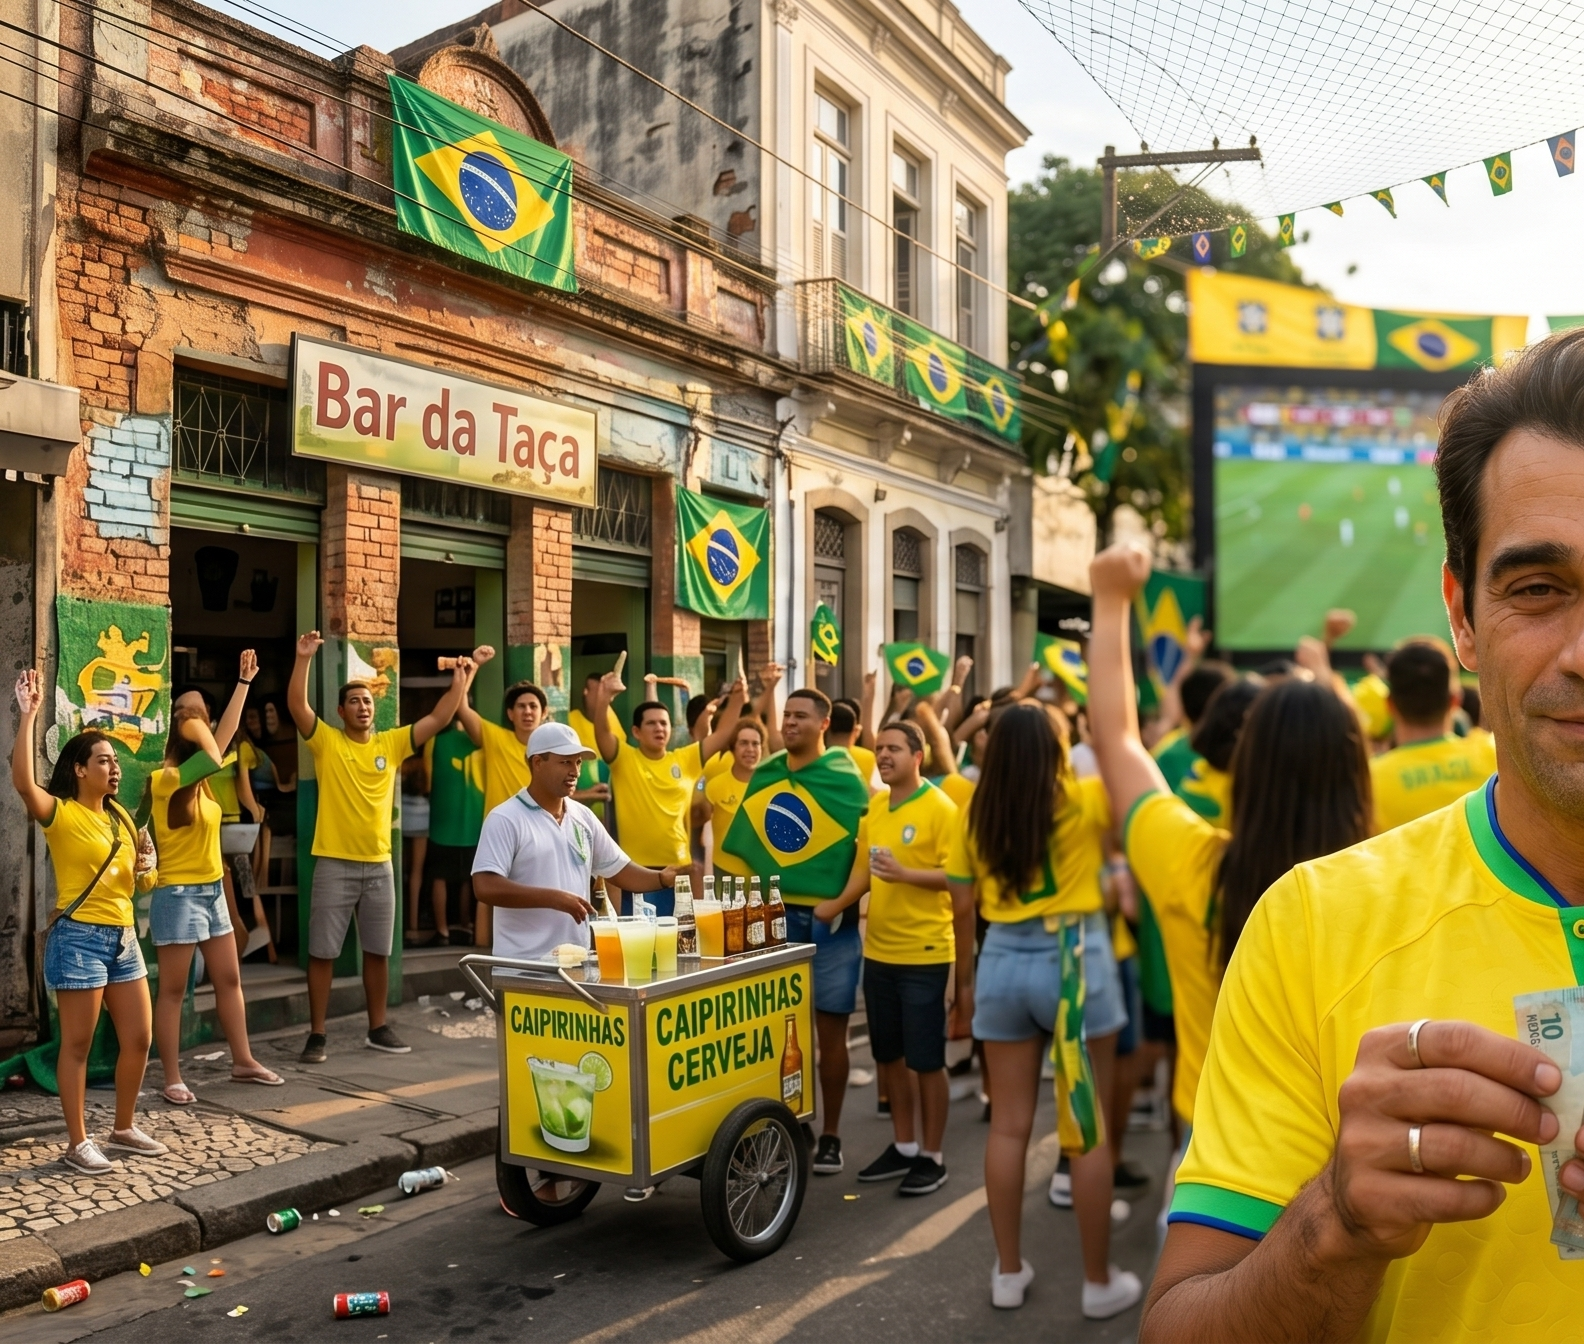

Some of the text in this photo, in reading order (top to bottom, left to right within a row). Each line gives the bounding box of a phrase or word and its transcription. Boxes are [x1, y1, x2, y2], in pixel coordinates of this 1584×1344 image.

[316, 361, 580, 485] Bar da Taça
[510, 1005, 625, 1047] CAIPIRINHAS
[656, 972, 803, 1046] CAIPIRINHAS
[1540, 1012, 1564, 1040] 10
[667, 1025, 774, 1091] CERVEJA
